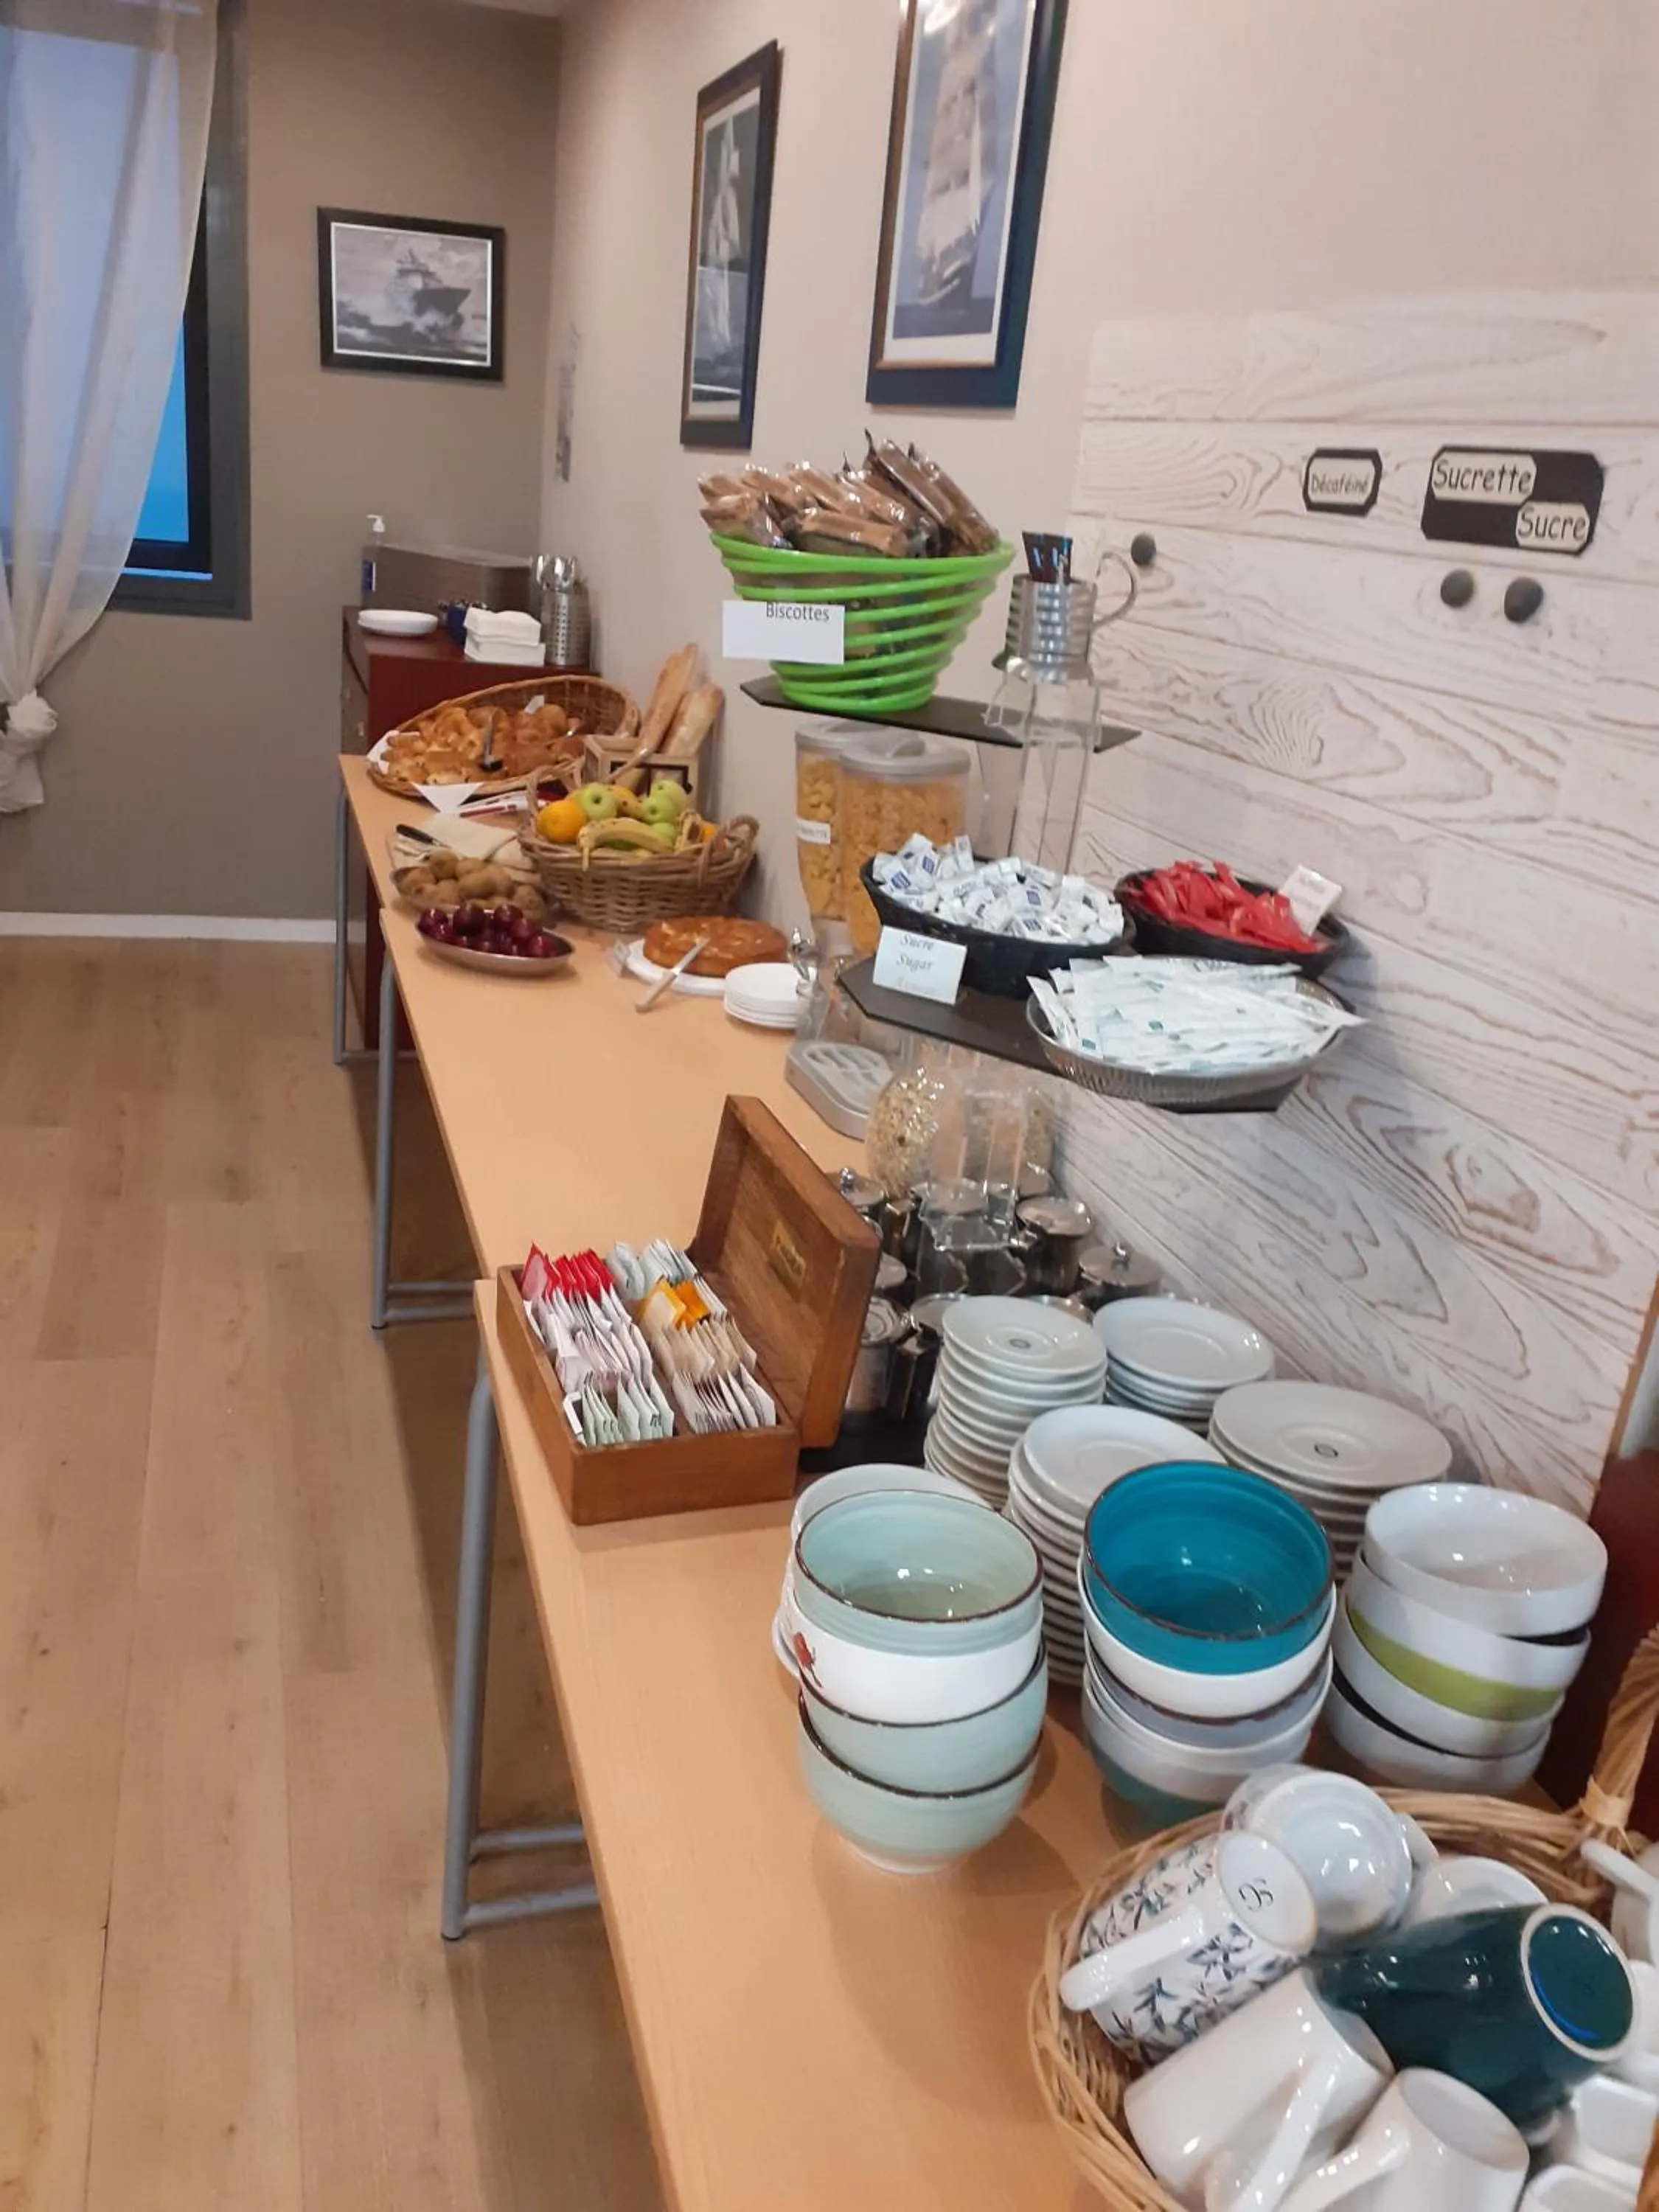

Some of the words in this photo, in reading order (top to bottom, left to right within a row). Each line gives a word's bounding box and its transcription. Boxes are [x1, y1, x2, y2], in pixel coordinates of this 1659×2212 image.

[1433, 459, 1531, 494] Sucrette
[1517, 502, 1586, 540] Sucre
[766, 602, 830, 622] Biscottes
[900, 934, 935, 951] Sucre
